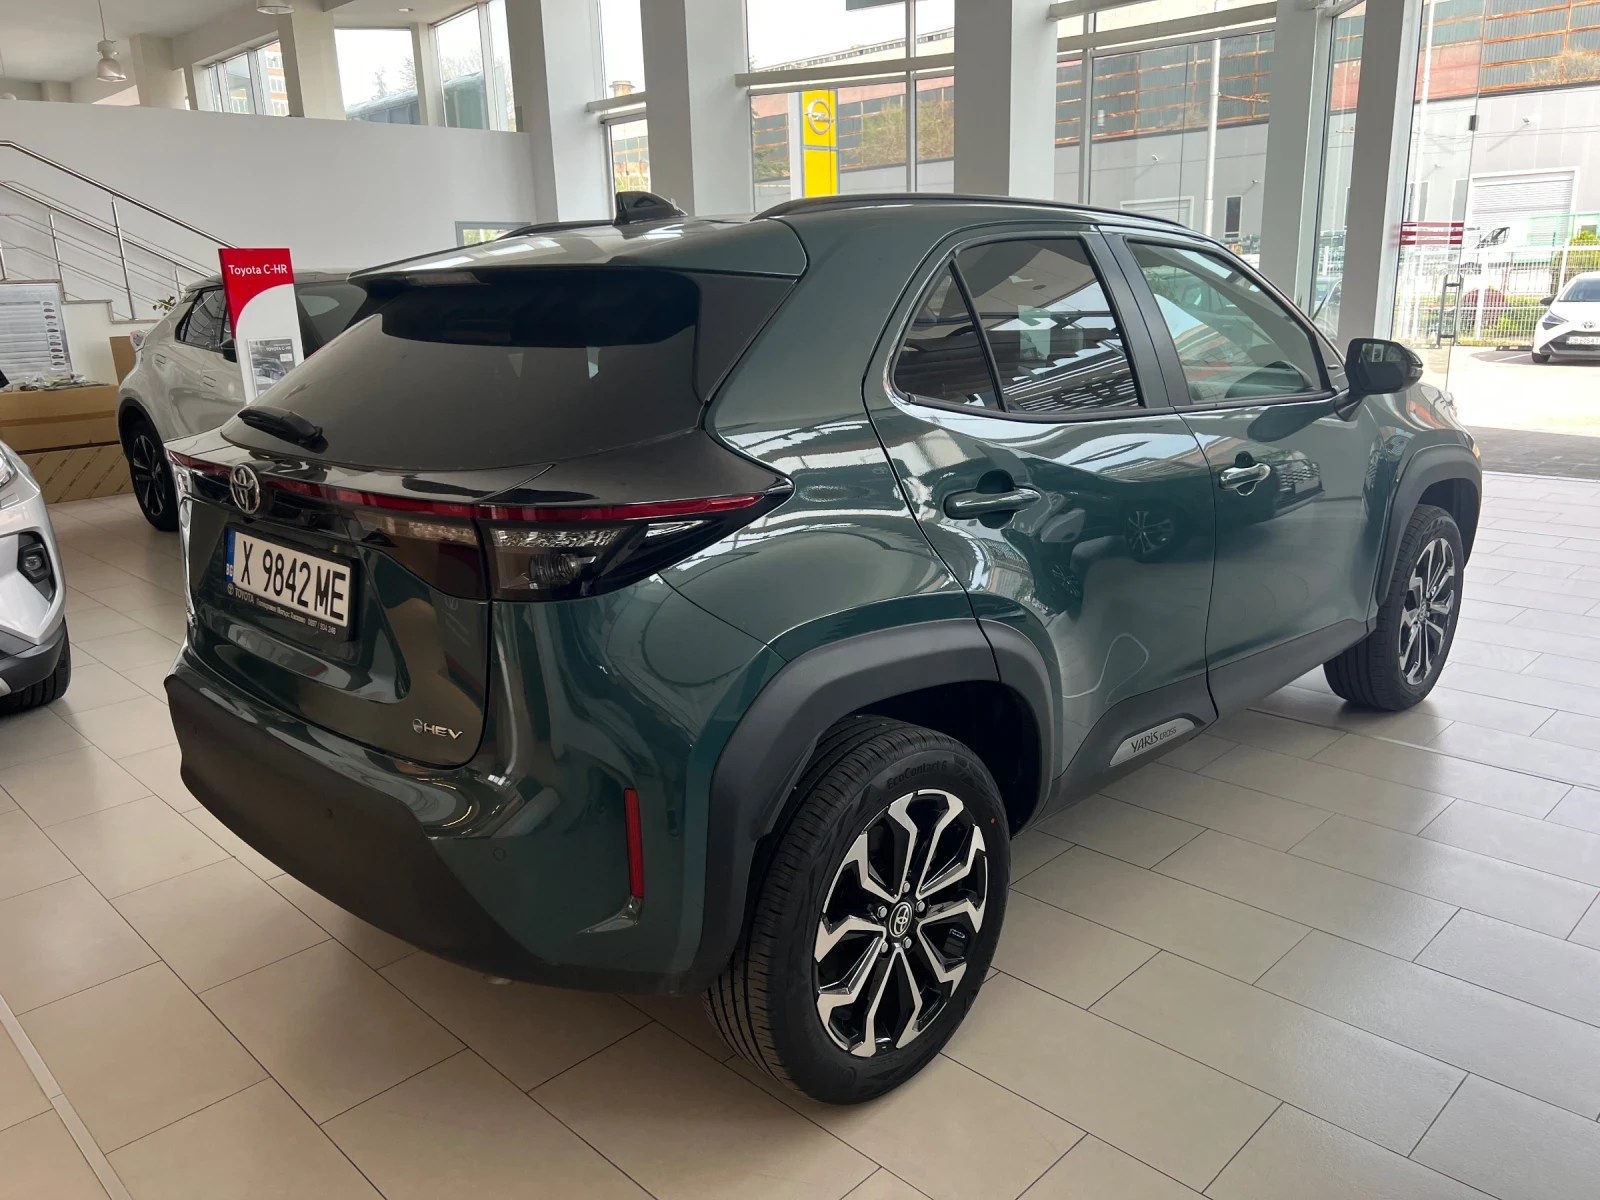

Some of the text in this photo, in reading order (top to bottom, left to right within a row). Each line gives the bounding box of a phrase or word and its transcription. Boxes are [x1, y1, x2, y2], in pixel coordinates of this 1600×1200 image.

[228, 264, 288, 276] Toyota C-HR
[226, 563, 234, 577] BG
[241, 540, 253, 586] X
[263, 549, 311, 608] 9842
[314, 566, 346, 620] ME
[235, 588, 255, 604] TOYOTA
[423, 723, 463, 739] HEV
[1159, 726, 1177, 741] CROSS
[886, 760, 948, 789] EcoContact 6
